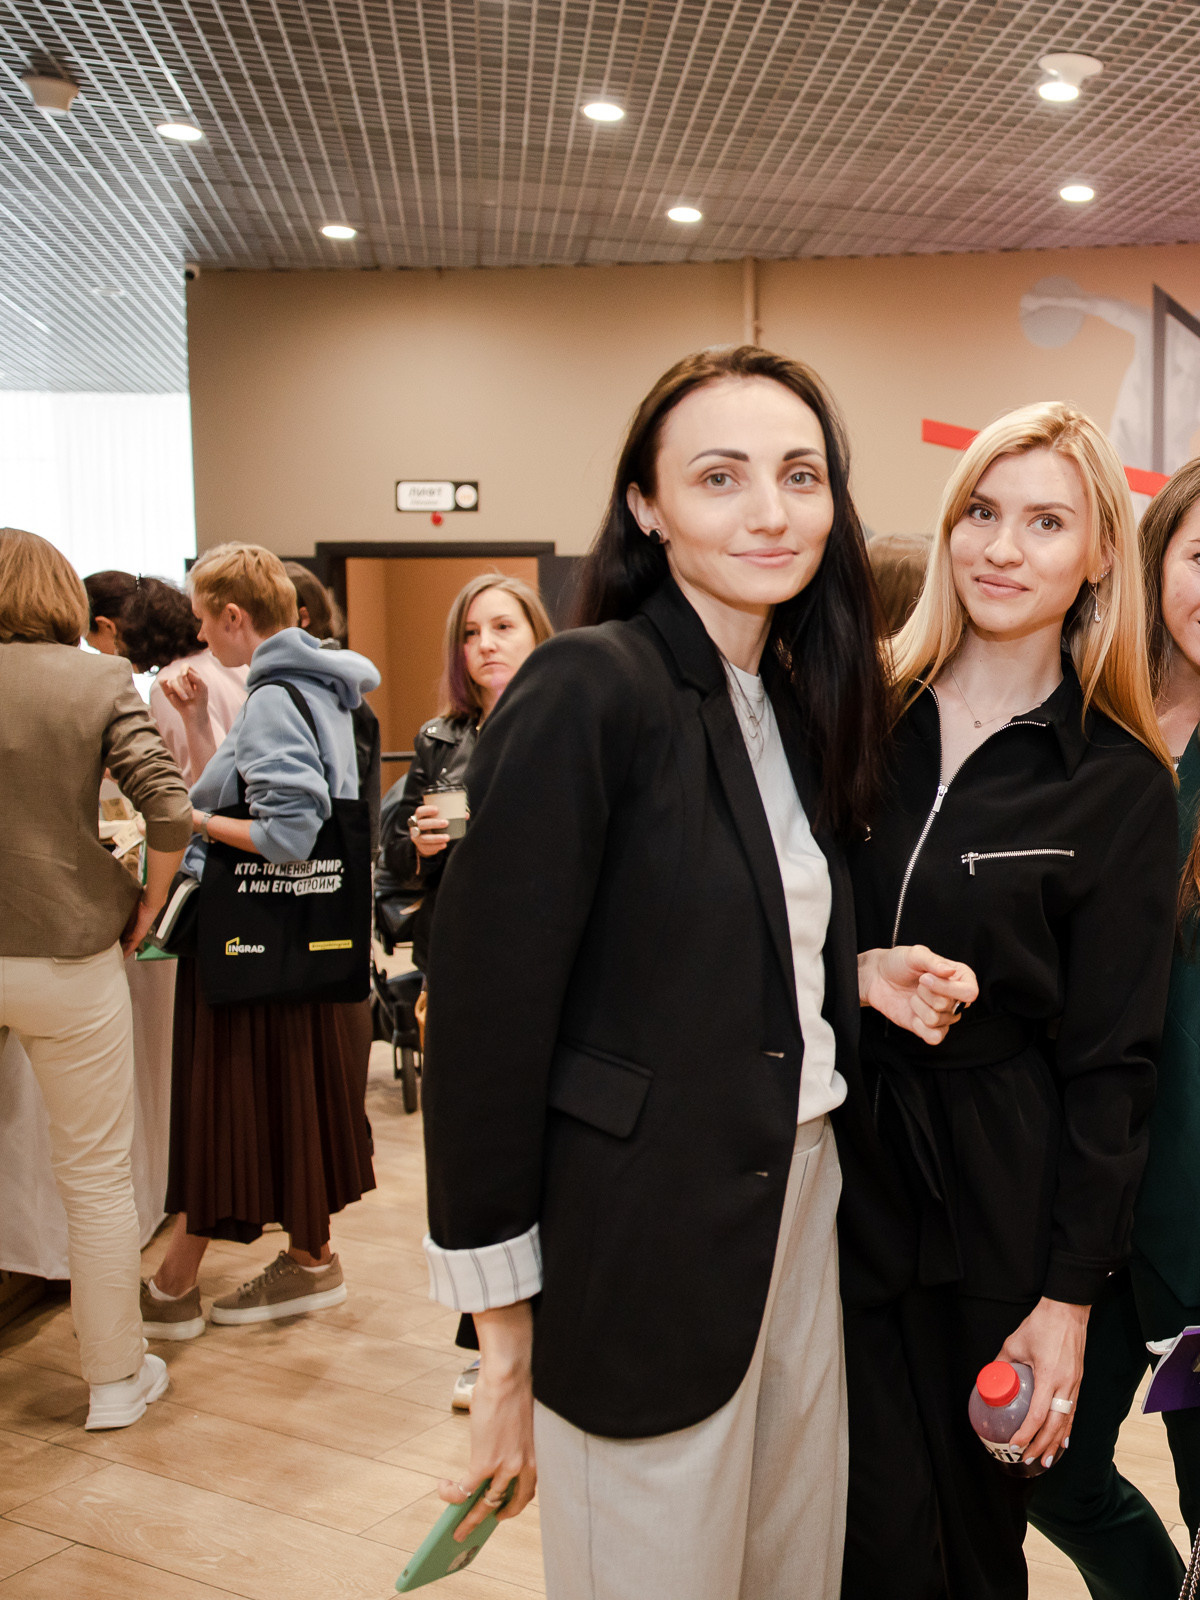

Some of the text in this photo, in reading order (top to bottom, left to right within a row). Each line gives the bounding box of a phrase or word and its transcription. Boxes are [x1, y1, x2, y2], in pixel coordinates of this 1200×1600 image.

[234, 862, 276, 875] КТО-ТО
[316, 859, 345, 874] МИР,
[238, 878, 335, 893] А МЫ ЕГО СТРОИМ
[229, 944, 266, 954] INGRAD
